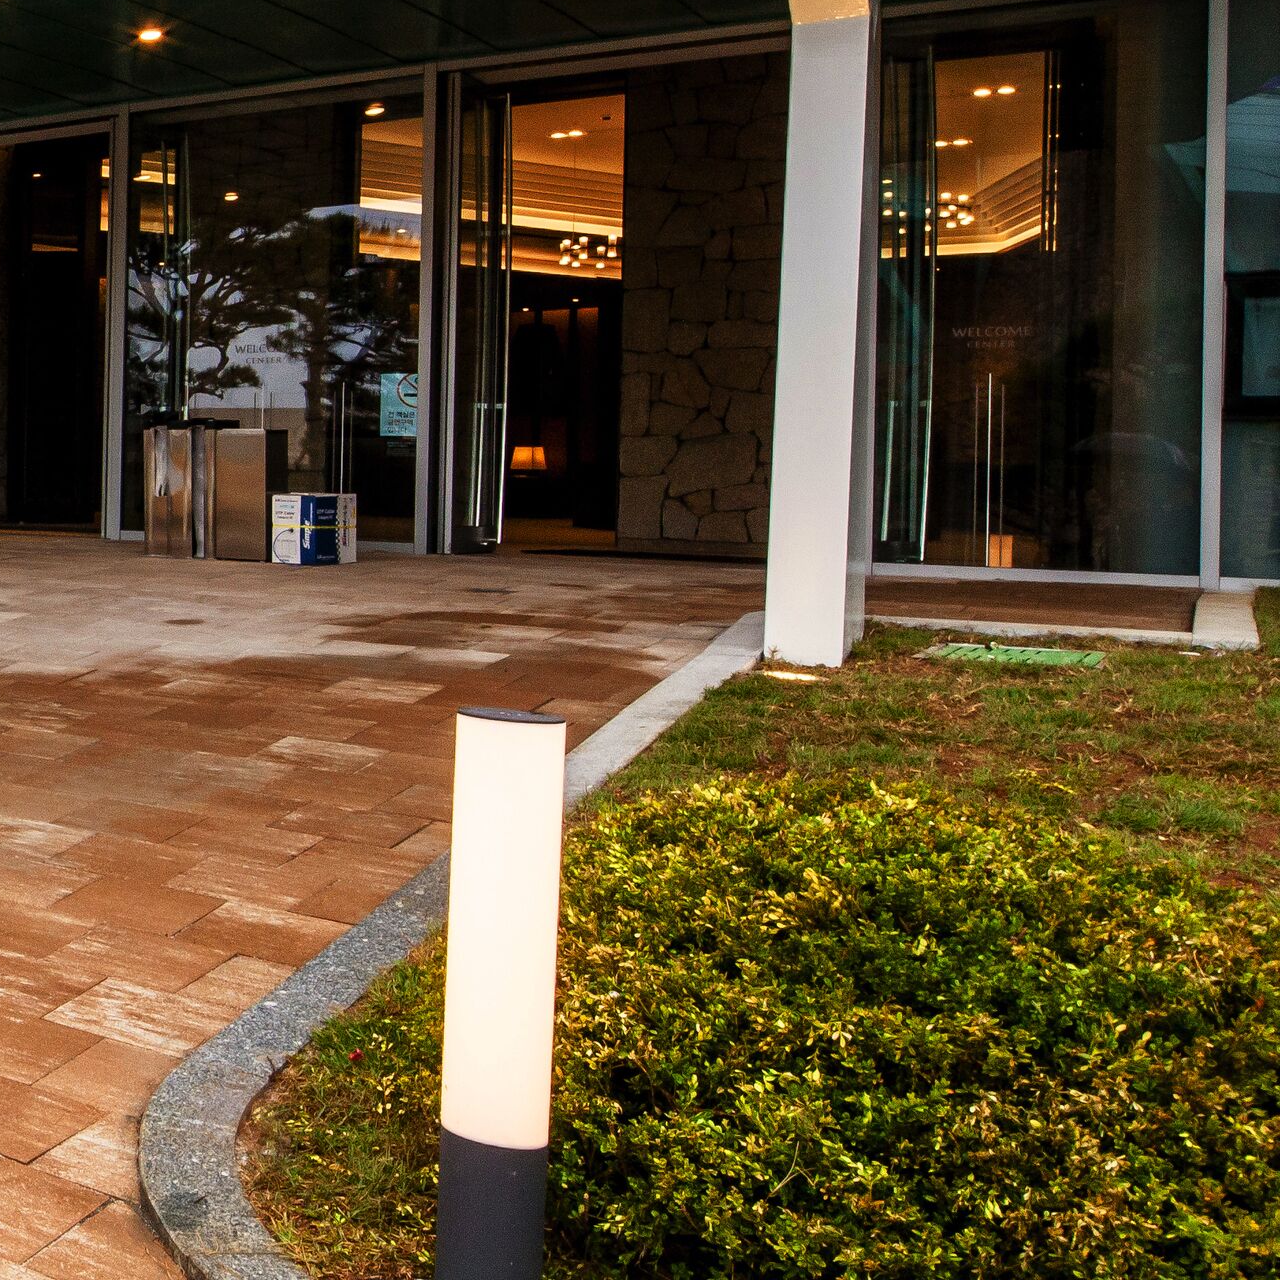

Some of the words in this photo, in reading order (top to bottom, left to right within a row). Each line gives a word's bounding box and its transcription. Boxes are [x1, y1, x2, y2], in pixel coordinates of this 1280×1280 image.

[952, 326, 1032, 337] WELCOME
[234, 344, 285, 354] WELCO
[302, 513, 313, 550] Simpe
